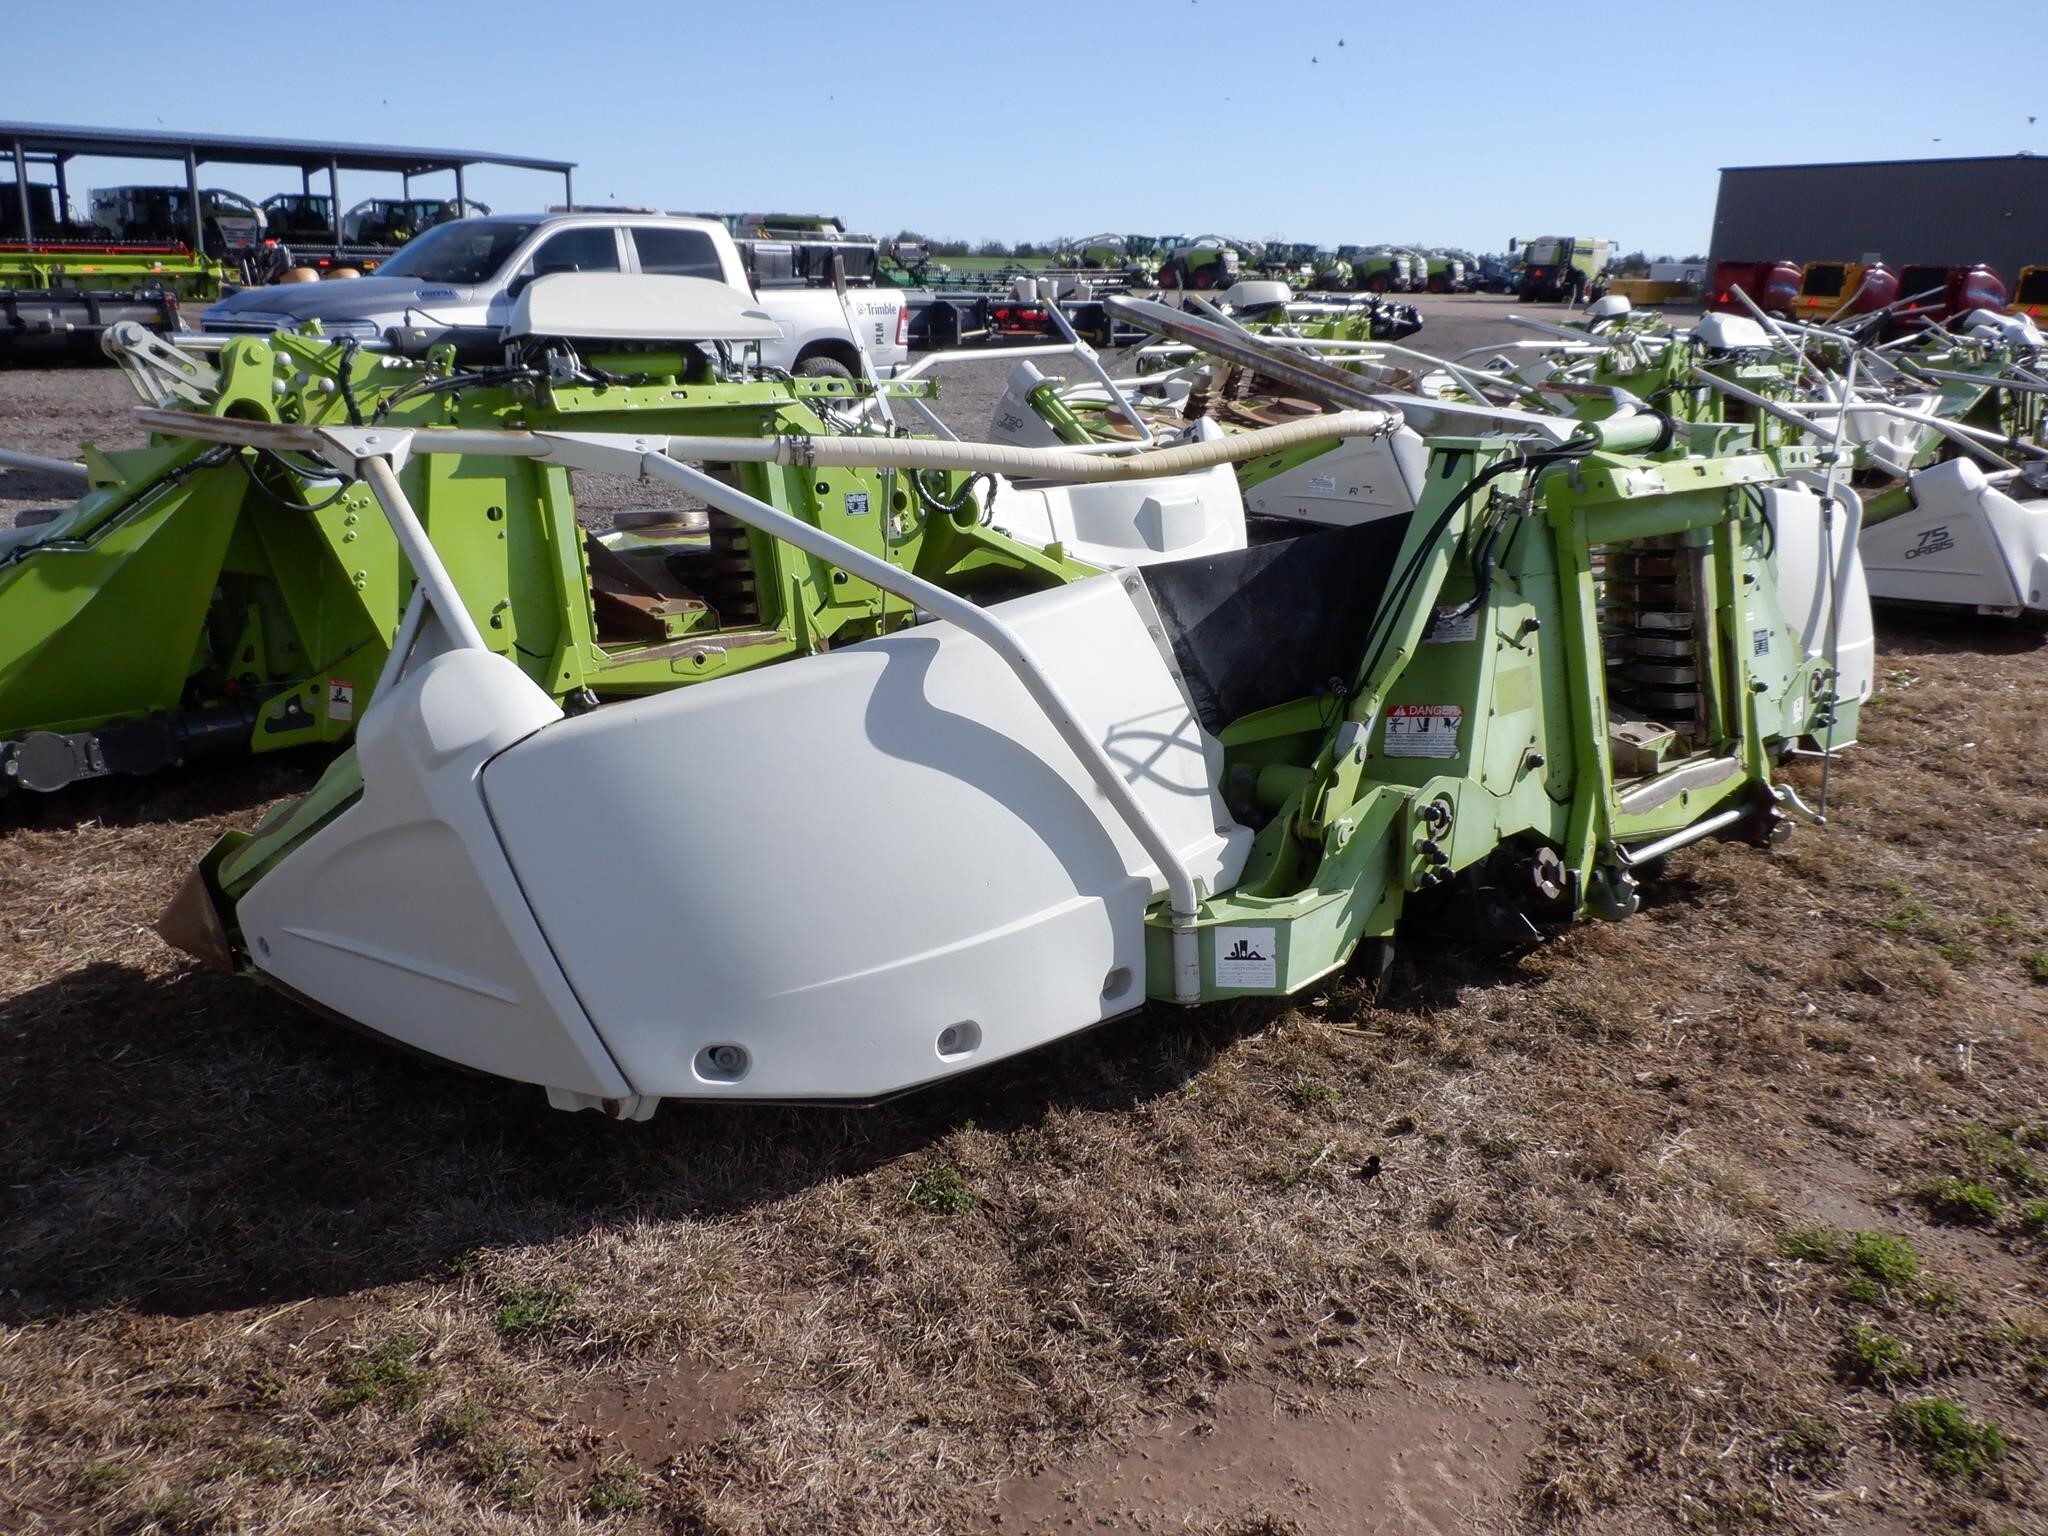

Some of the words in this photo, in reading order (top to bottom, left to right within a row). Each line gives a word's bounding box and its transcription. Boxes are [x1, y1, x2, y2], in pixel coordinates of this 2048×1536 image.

[866, 303, 896, 315] Trimble
[875, 322, 884, 345] PLM
[1917, 526, 1949, 547] 75
[1905, 538, 1954, 560] ORBIS
